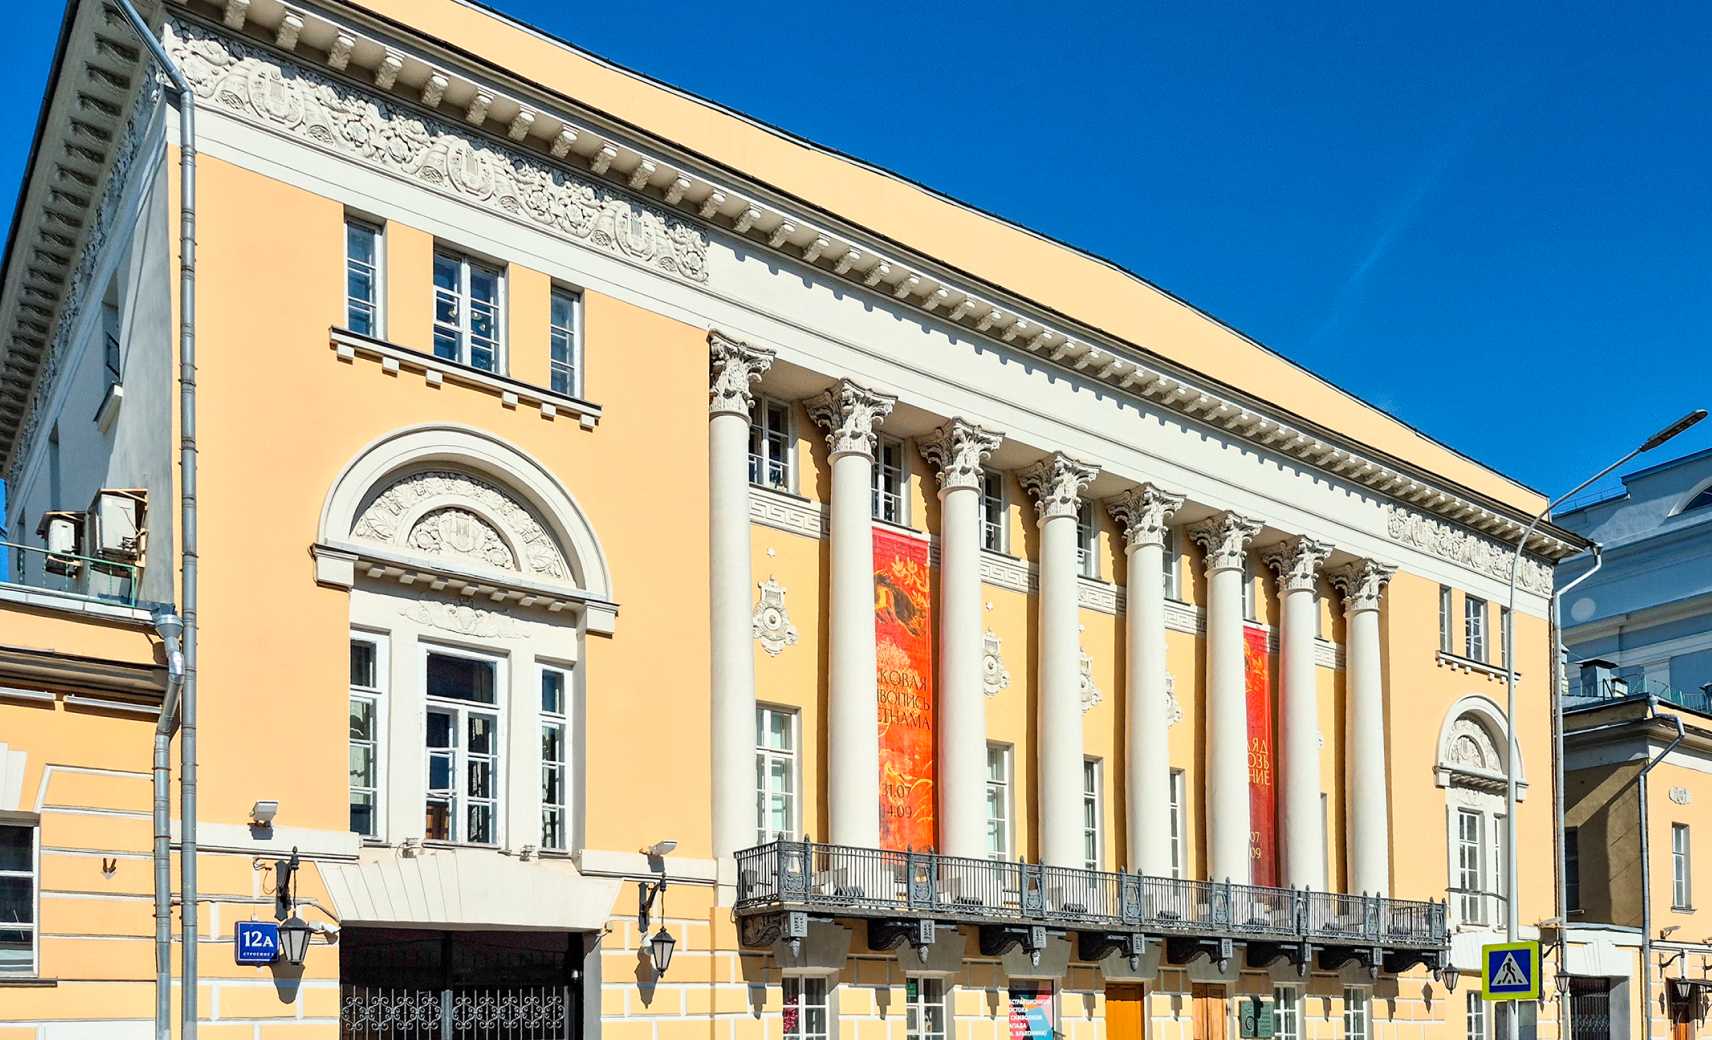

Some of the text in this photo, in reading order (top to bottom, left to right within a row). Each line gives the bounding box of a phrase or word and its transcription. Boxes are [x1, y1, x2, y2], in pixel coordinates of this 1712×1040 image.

[880, 669, 926, 691] КОВАЯ
[881, 783, 912, 798] 31.07
[243, 930, 274, 947] 12А
